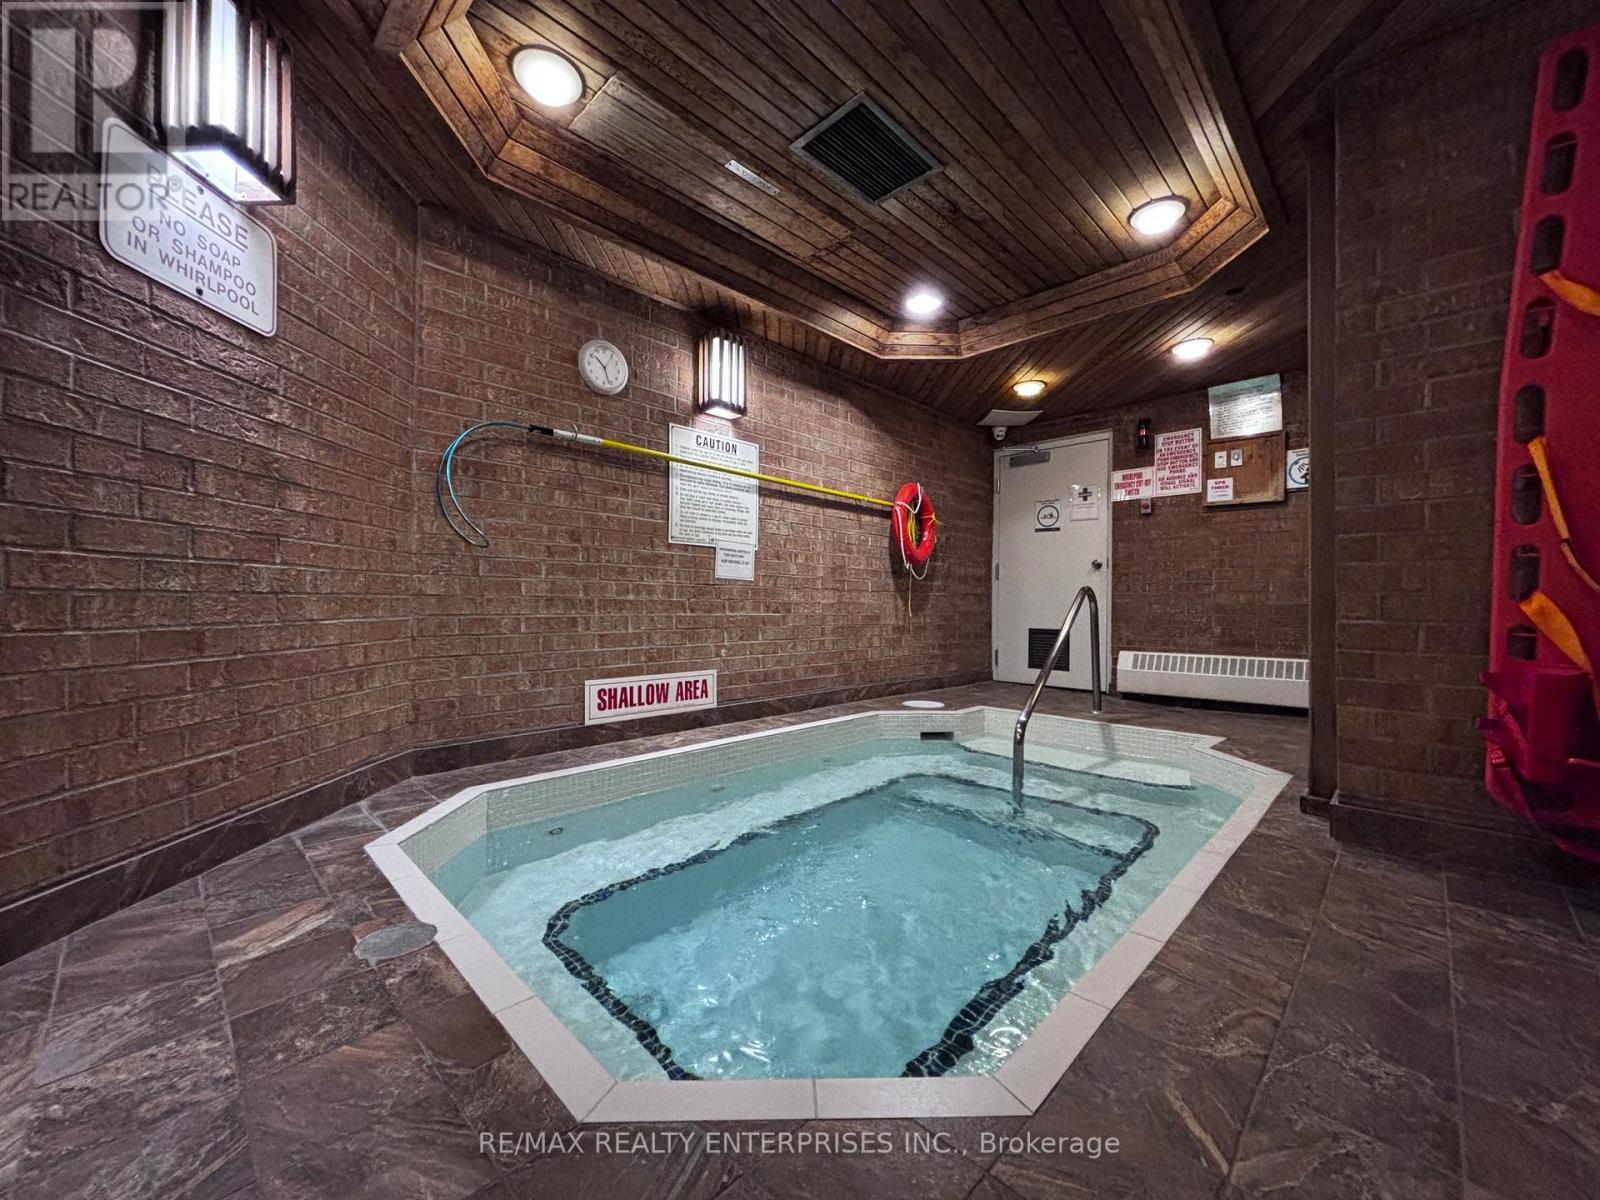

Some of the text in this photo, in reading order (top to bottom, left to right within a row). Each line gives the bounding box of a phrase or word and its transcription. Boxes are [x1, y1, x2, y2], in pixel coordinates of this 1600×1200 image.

[132, 215, 257, 297] OR SHAMPOO
[159, 211, 242, 268] NO SOAP
[127, 231, 260, 316] IN WHIRLPOOL
[695, 434, 738, 454] CAUTION
[597, 679, 709, 711] SHALLOW AREA
